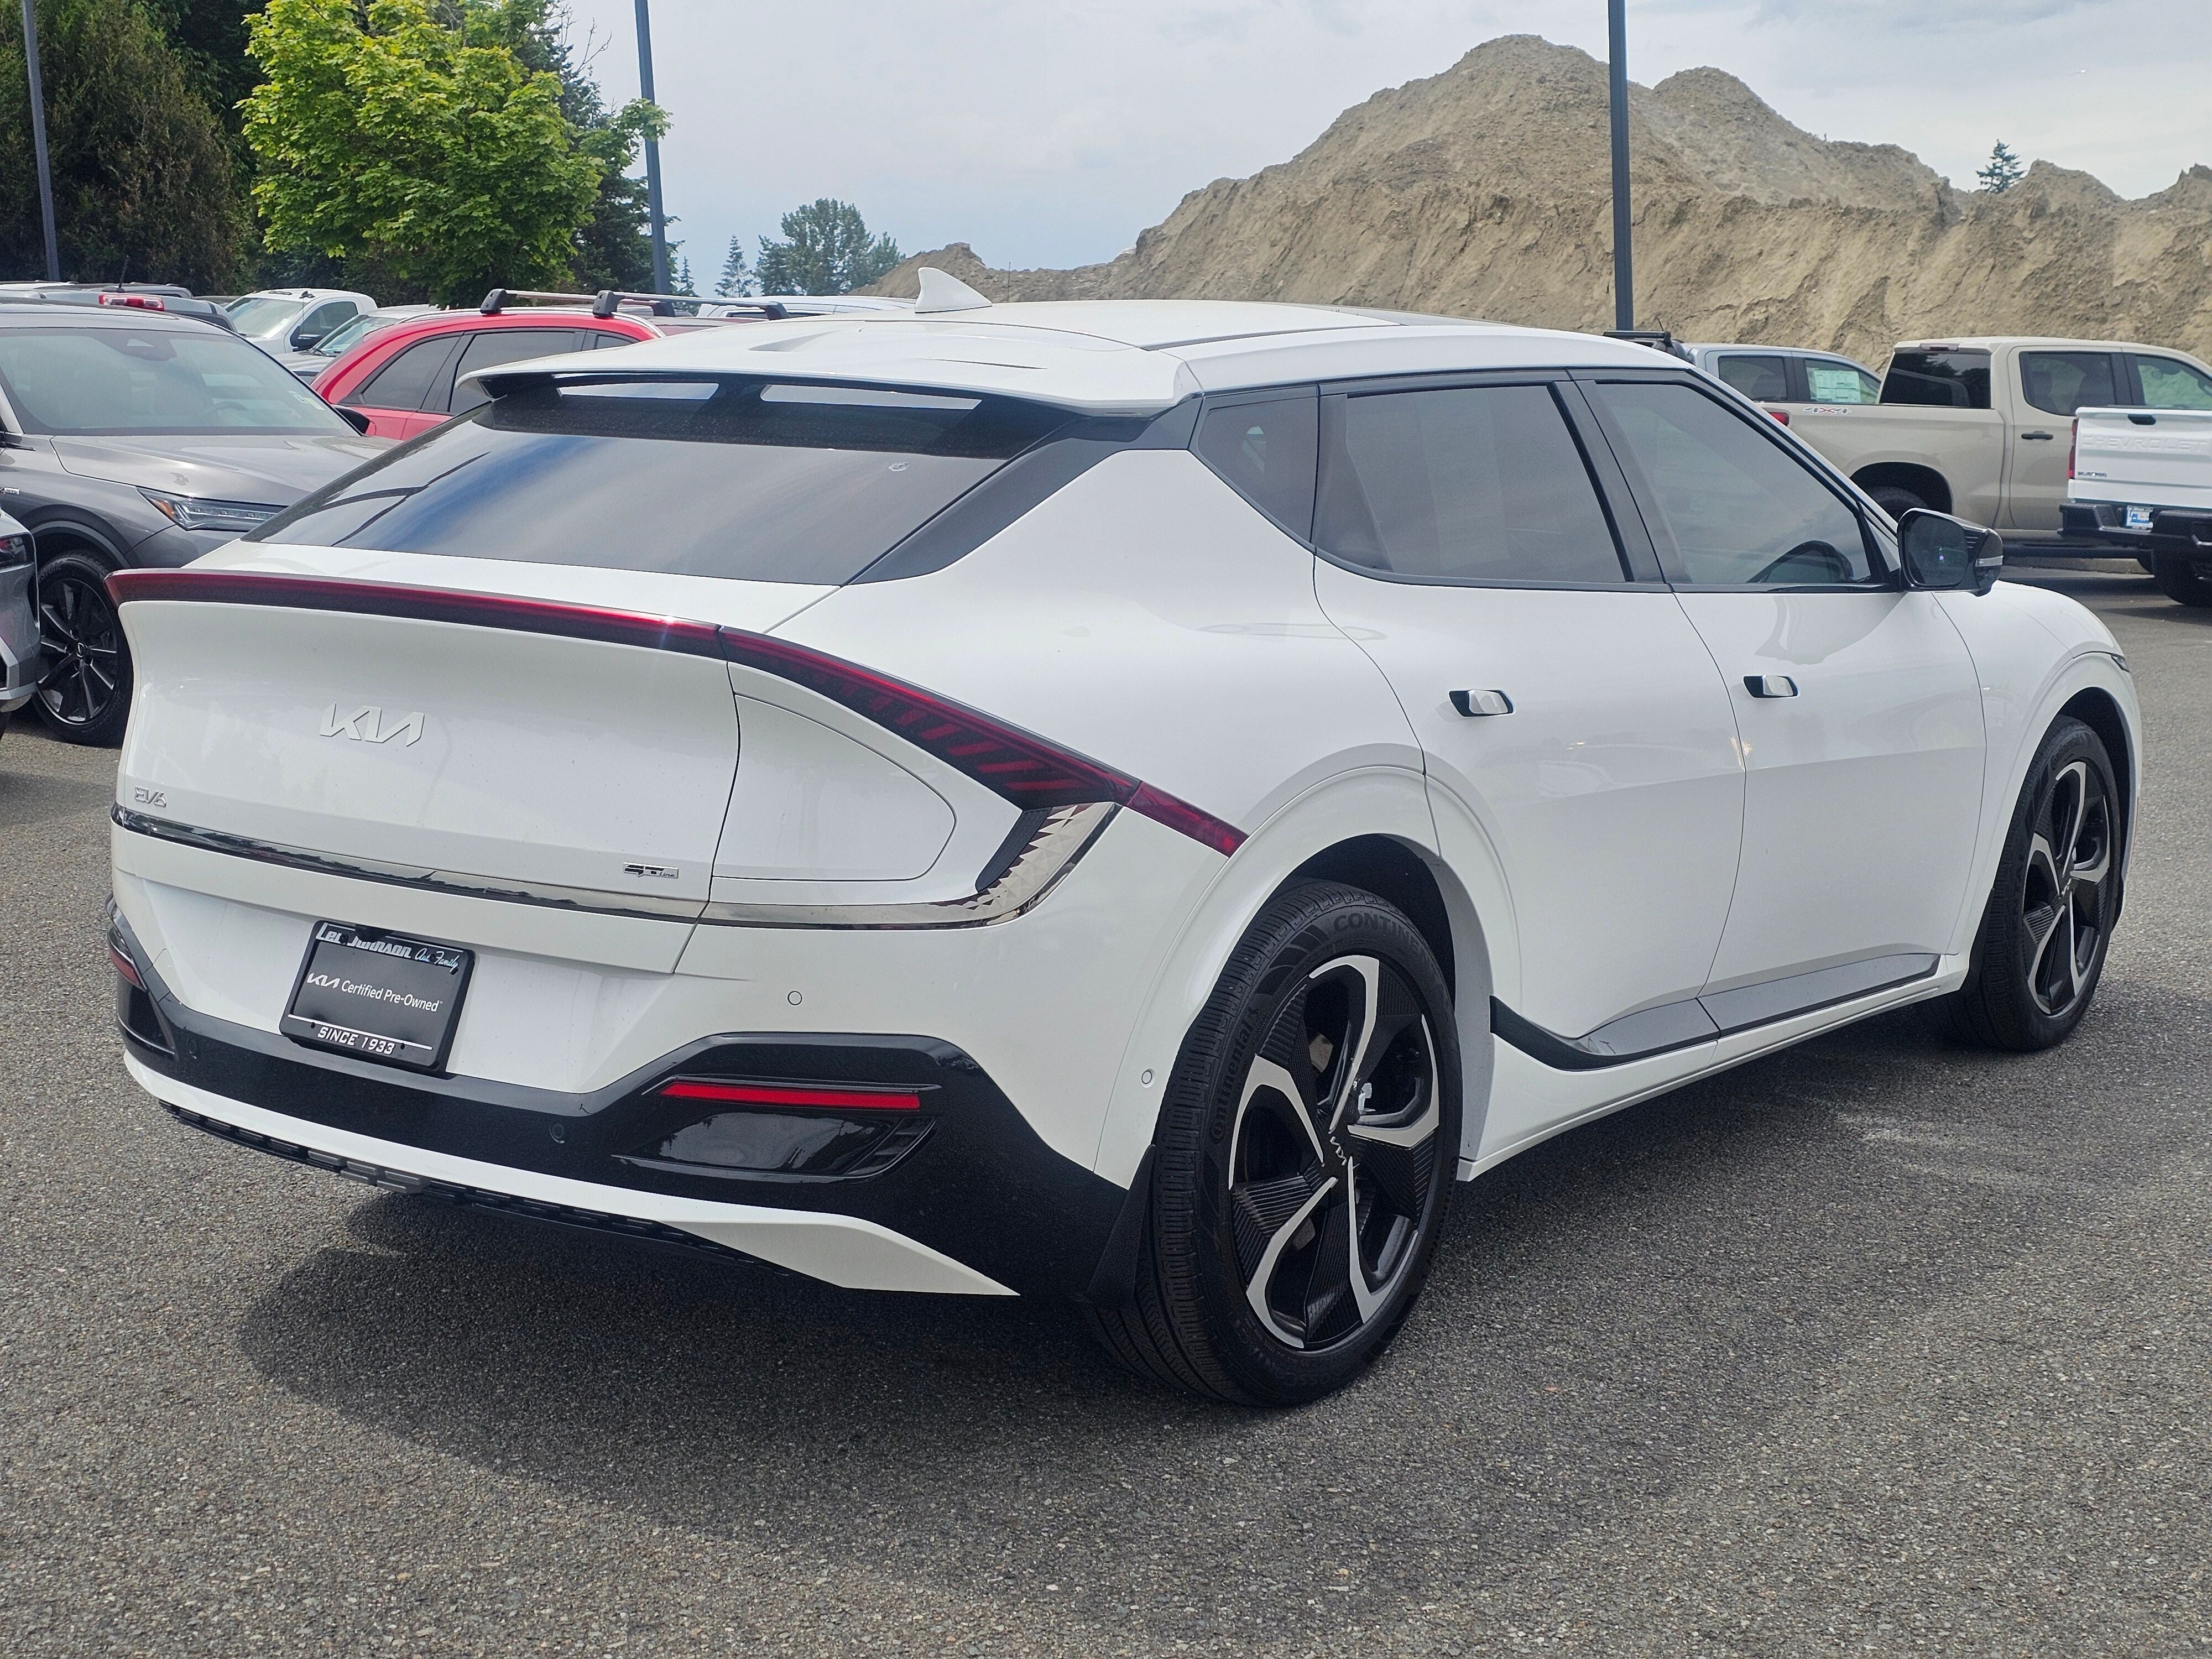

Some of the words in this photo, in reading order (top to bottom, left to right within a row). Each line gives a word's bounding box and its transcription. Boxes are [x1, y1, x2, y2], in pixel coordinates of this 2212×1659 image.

[2081, 435, 2209, 452] CHEVROLET
[320, 702, 425, 747] KIA
[134, 785, 166, 808] EV6
[306, 973, 340, 988] KIA
[341, 980, 384, 999] Certified
[317, 1026, 358, 1046] SINCE
[361, 1037, 395, 1055] 1933
